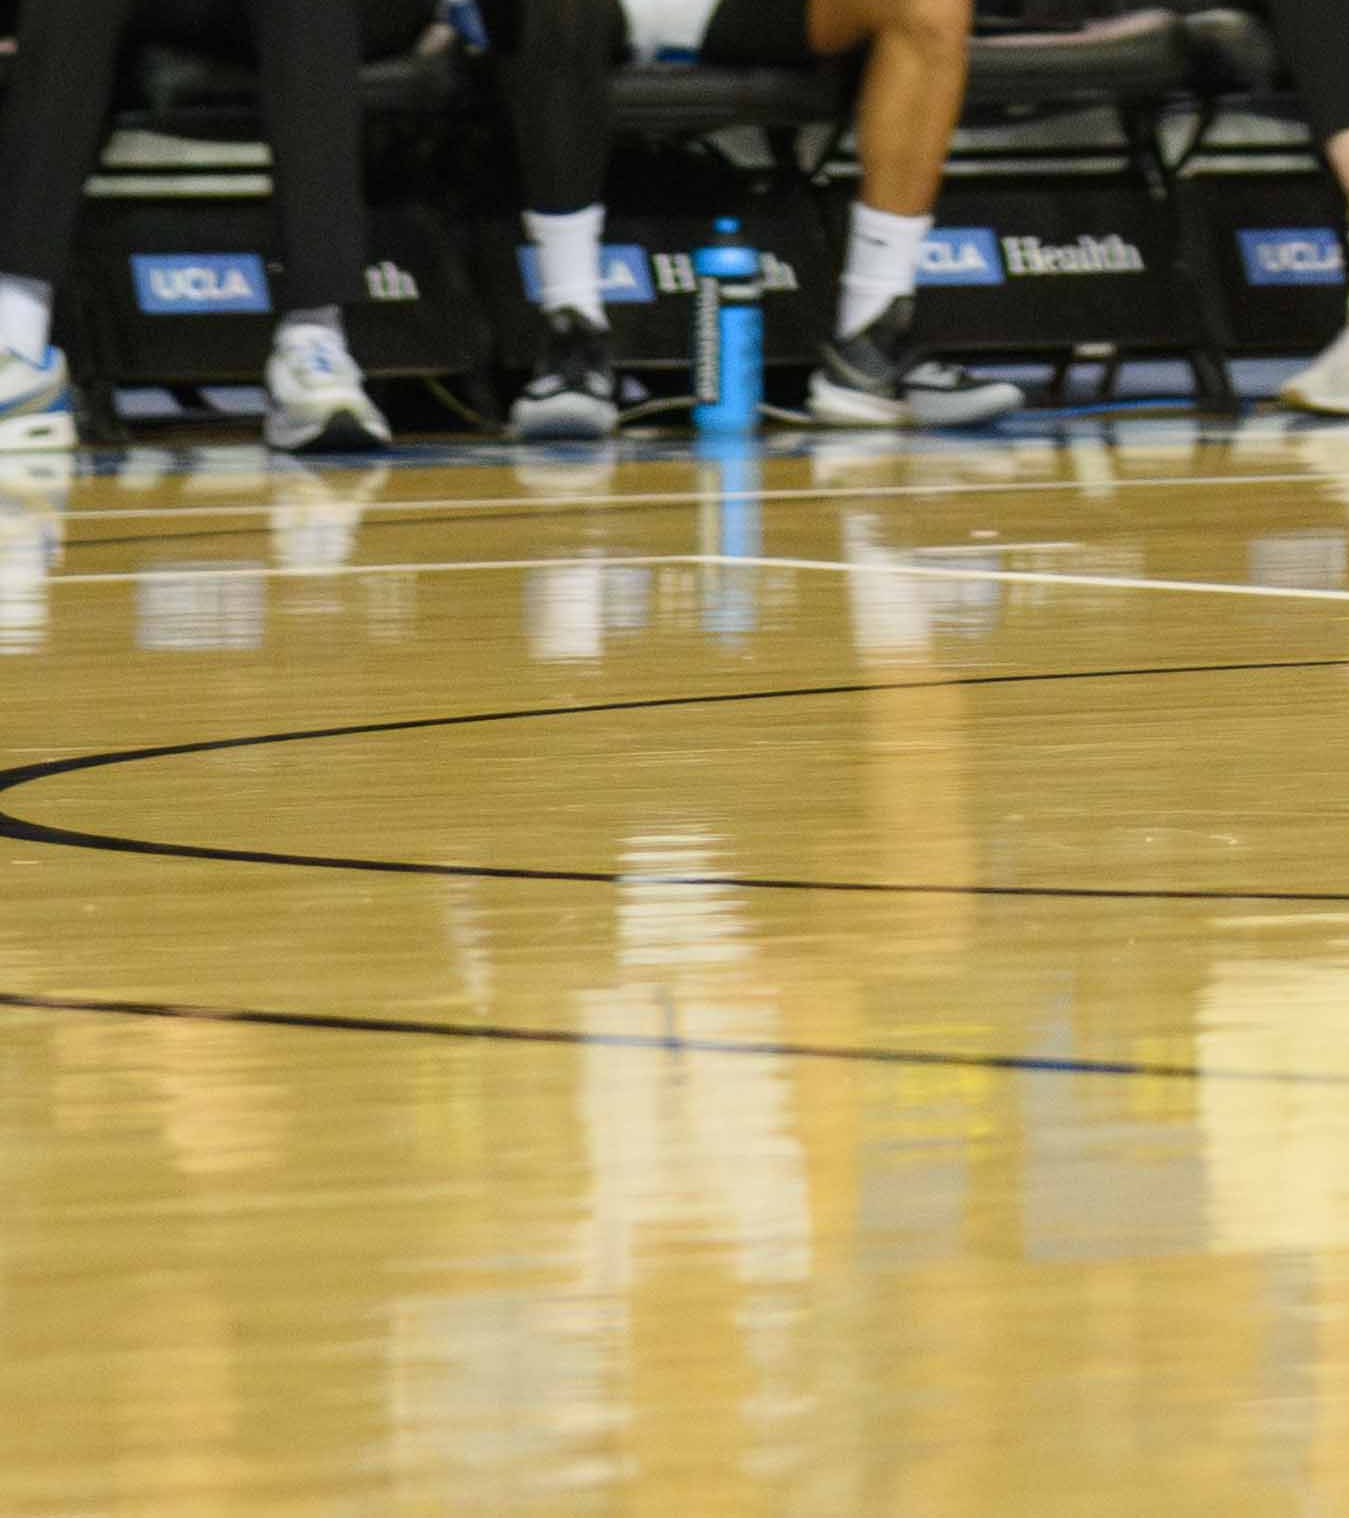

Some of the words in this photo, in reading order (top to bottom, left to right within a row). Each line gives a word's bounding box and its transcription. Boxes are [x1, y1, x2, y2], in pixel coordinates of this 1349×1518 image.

[918, 240, 989, 273] CLA
[1001, 233, 1147, 275] Health
[149, 266, 255, 301] UCLA
